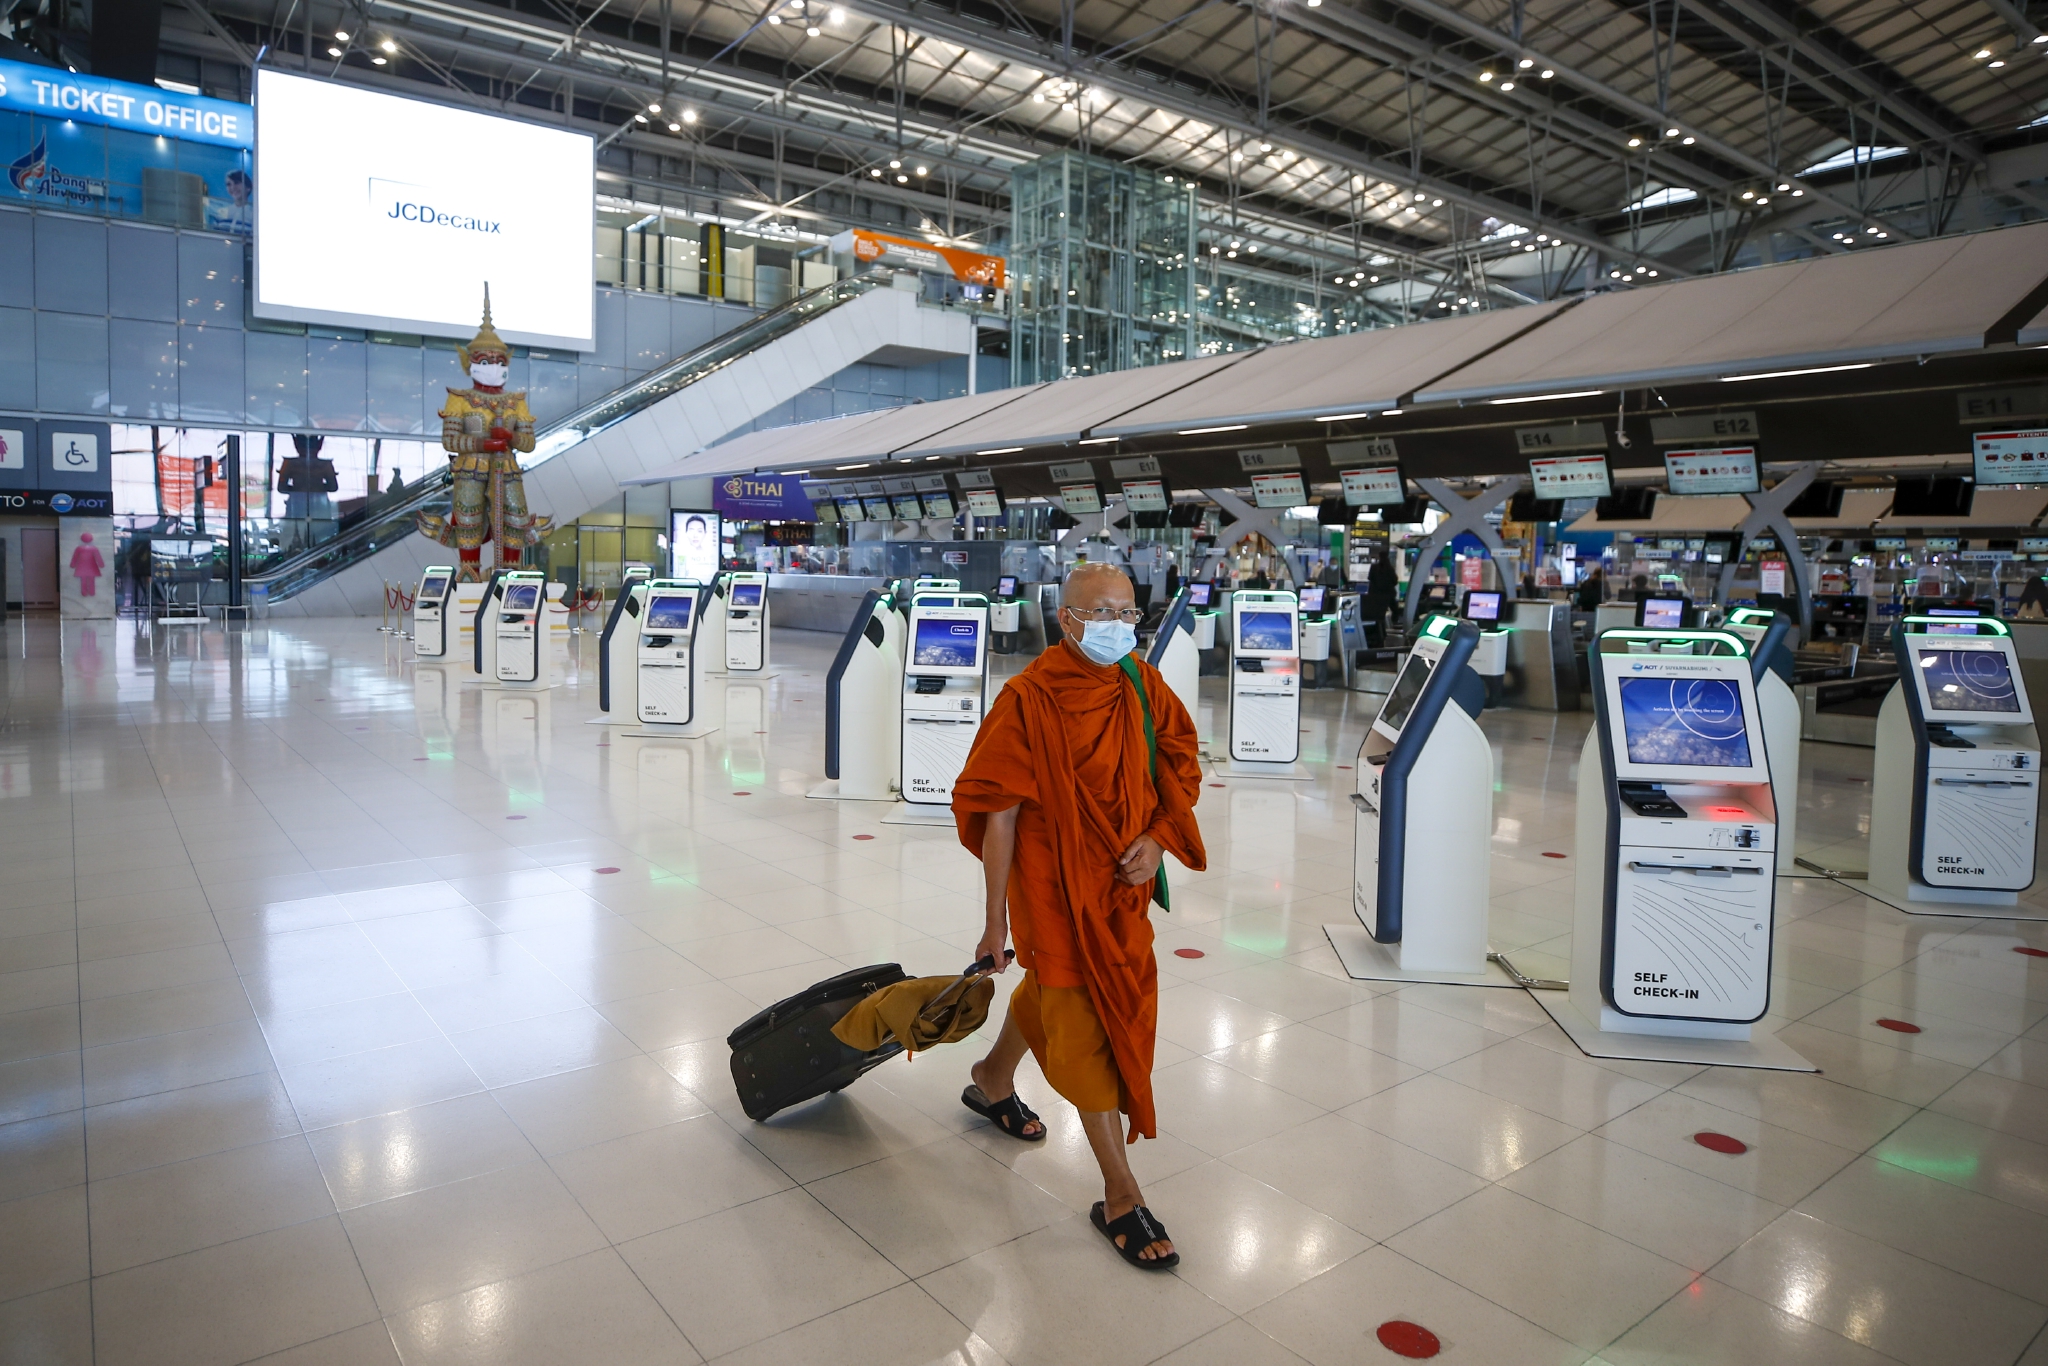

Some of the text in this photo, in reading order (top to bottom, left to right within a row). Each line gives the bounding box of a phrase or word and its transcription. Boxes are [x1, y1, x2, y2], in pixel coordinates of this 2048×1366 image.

[31, 79, 135, 120] TICKET
[143, 100, 238, 139] OFFICE
[387, 201, 501, 234] JCDecaux
[1967, 396, 2013, 416] E11
[1713, 418, 1750, 434] E12
[1522, 432, 1552, 447] E14
[1366, 443, 1392, 457] E15
[1242, 453, 1264, 465] E16
[1138, 461, 1156, 472] E17
[976, 474, 991, 484] E19
[1052, 468, 1068, 478] E18
[744, 481, 783, 497] THAI
[0, 495, 26, 508] TO
[75, 499, 107, 509] AOT
[785, 528, 811, 539] THAI
[912, 786, 946, 794] CHECK-IN
[1937, 856, 1963, 864] SELF
[1936, 866, 1985, 875] CHECK-IN
[1633, 972, 1668, 983] SELF
[1633, 986, 1699, 999] CHECK-IN
